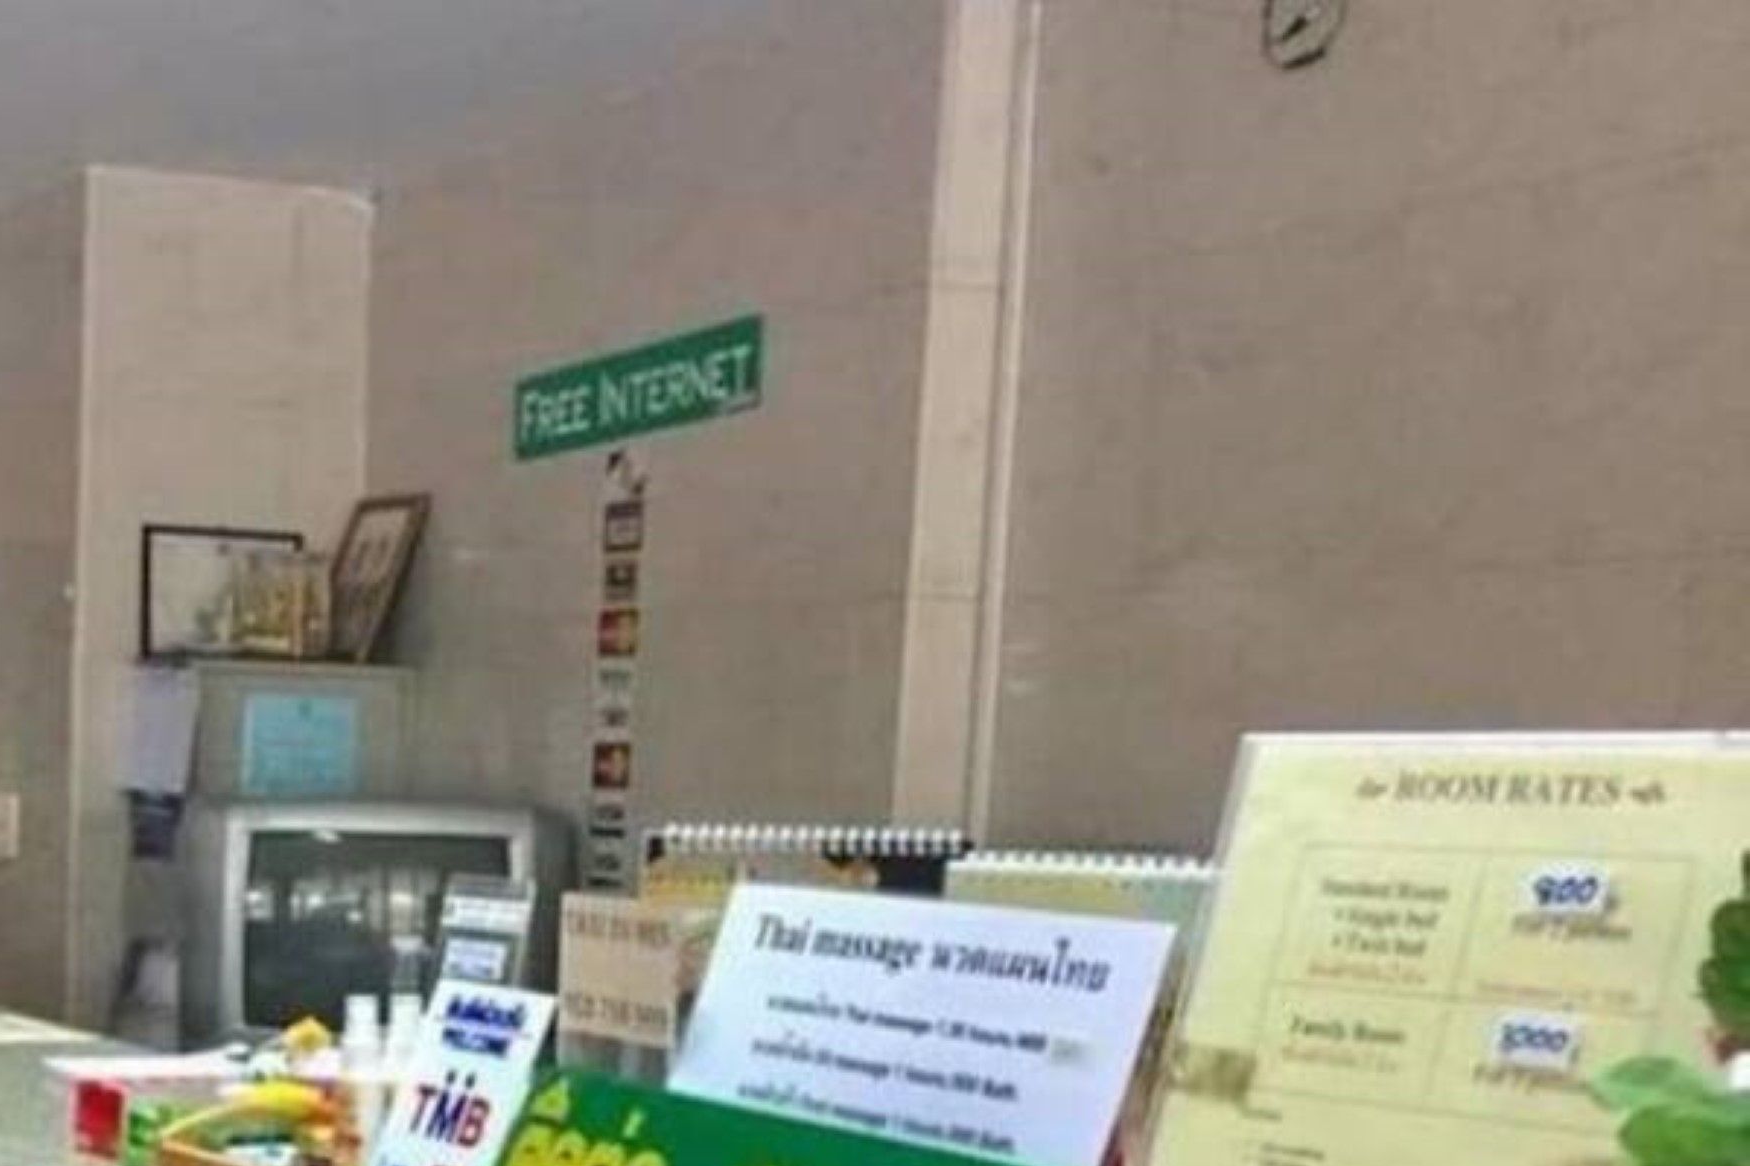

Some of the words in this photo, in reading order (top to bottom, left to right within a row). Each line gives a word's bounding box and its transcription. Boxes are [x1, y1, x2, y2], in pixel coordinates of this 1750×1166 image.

[521, 384, 591, 442] FREE
[598, 344, 753, 426] INTERNET
[1394, 771, 1497, 801] ROOM
[1509, 772, 1621, 804] RATES
[754, 914, 812, 955] Thai
[810, 929, 923, 976] massage
[409, 1082, 491, 1148] TMB
